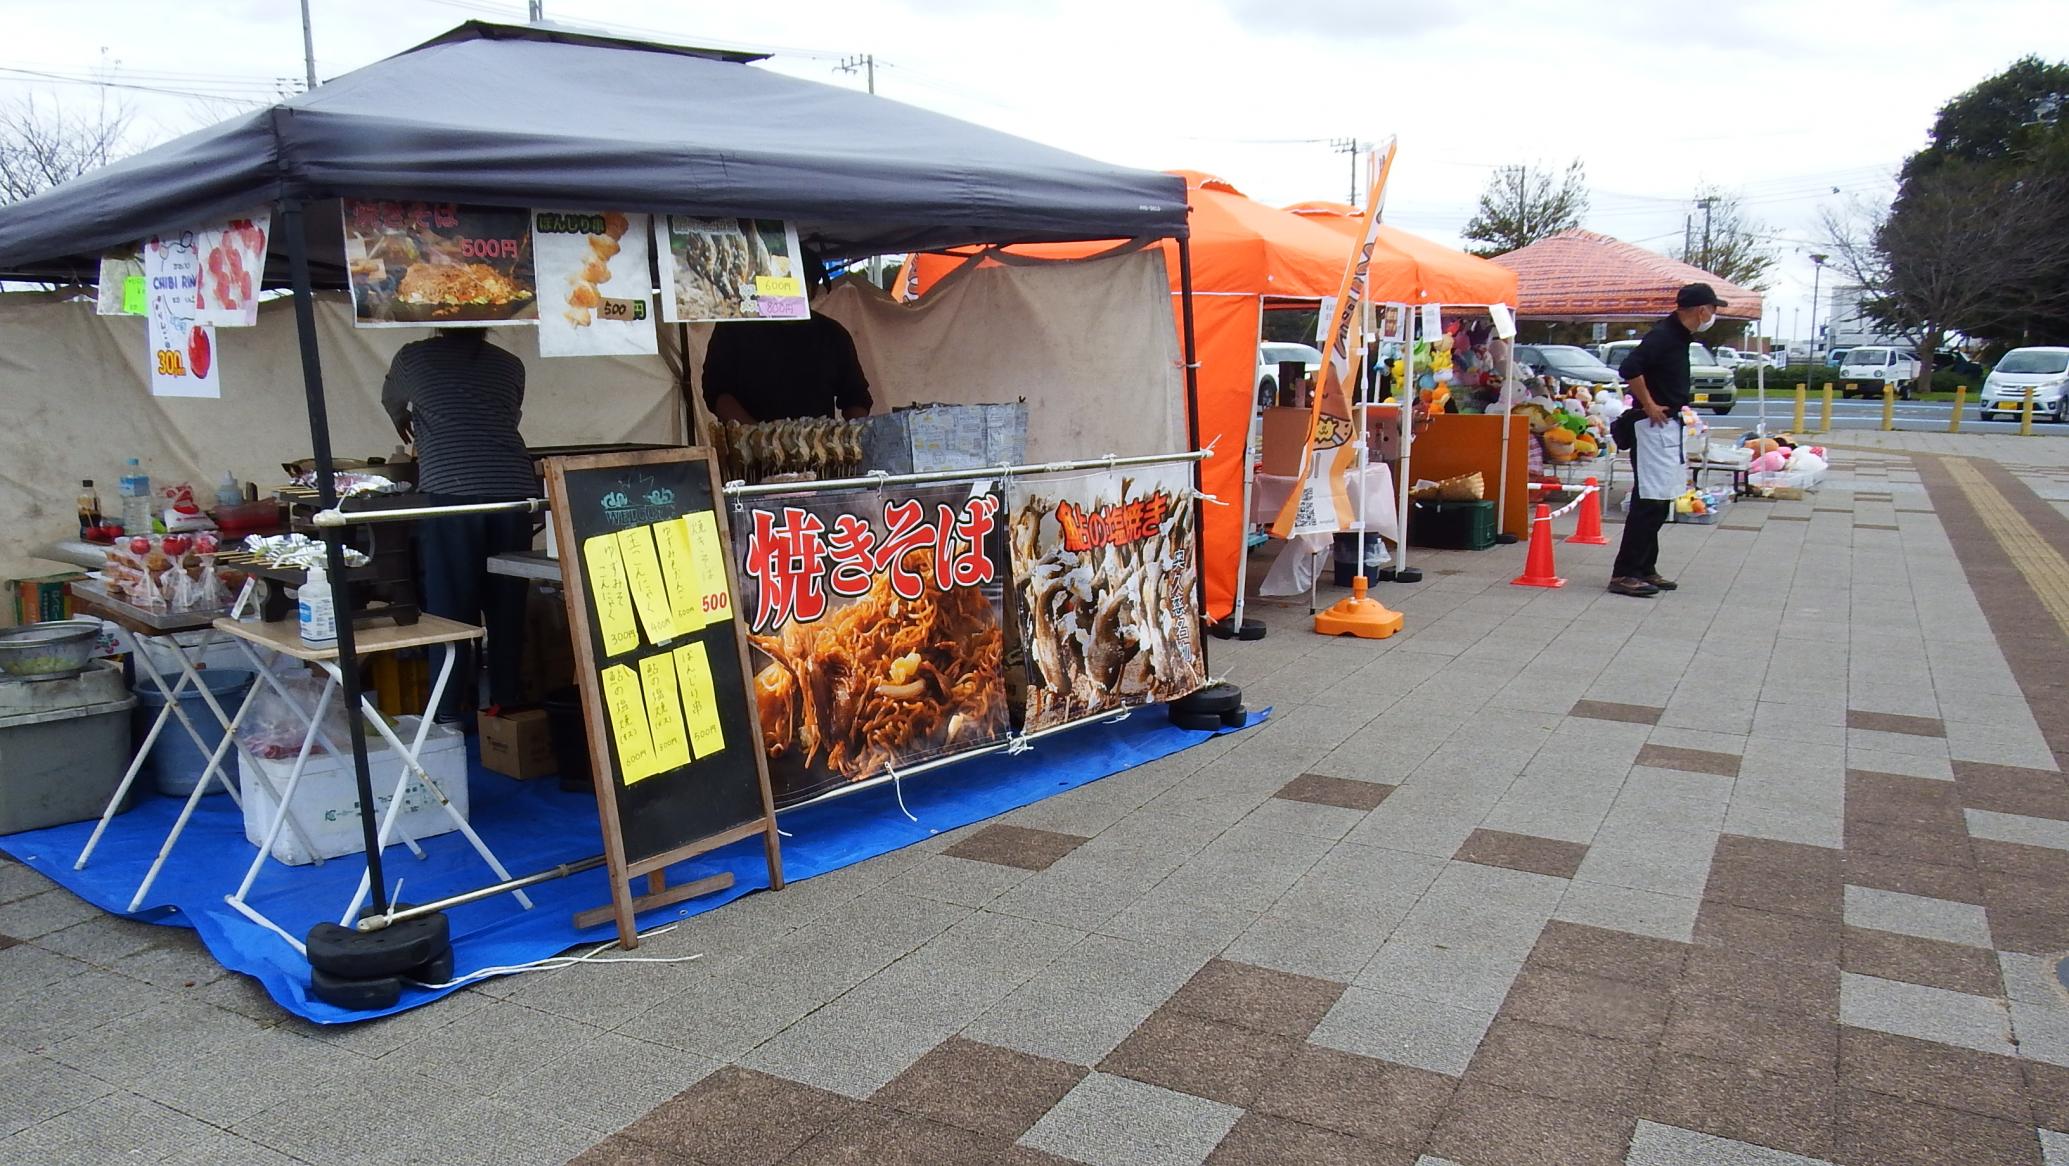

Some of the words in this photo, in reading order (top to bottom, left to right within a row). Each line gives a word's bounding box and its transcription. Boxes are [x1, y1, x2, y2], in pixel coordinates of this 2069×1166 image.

[462, 239, 518, 258] 500円
[153, 276, 178, 291] CHIBI
[765, 282, 792, 292] 600円
[1055, 489, 1169, 553] 鮎の塩焼き
[691, 519, 714, 583] 焼きそば
[747, 493, 1000, 634] 焼きそば
[702, 592, 728, 613] 500
[611, 629, 636, 646] 300円
[693, 723, 717, 742] 500円
